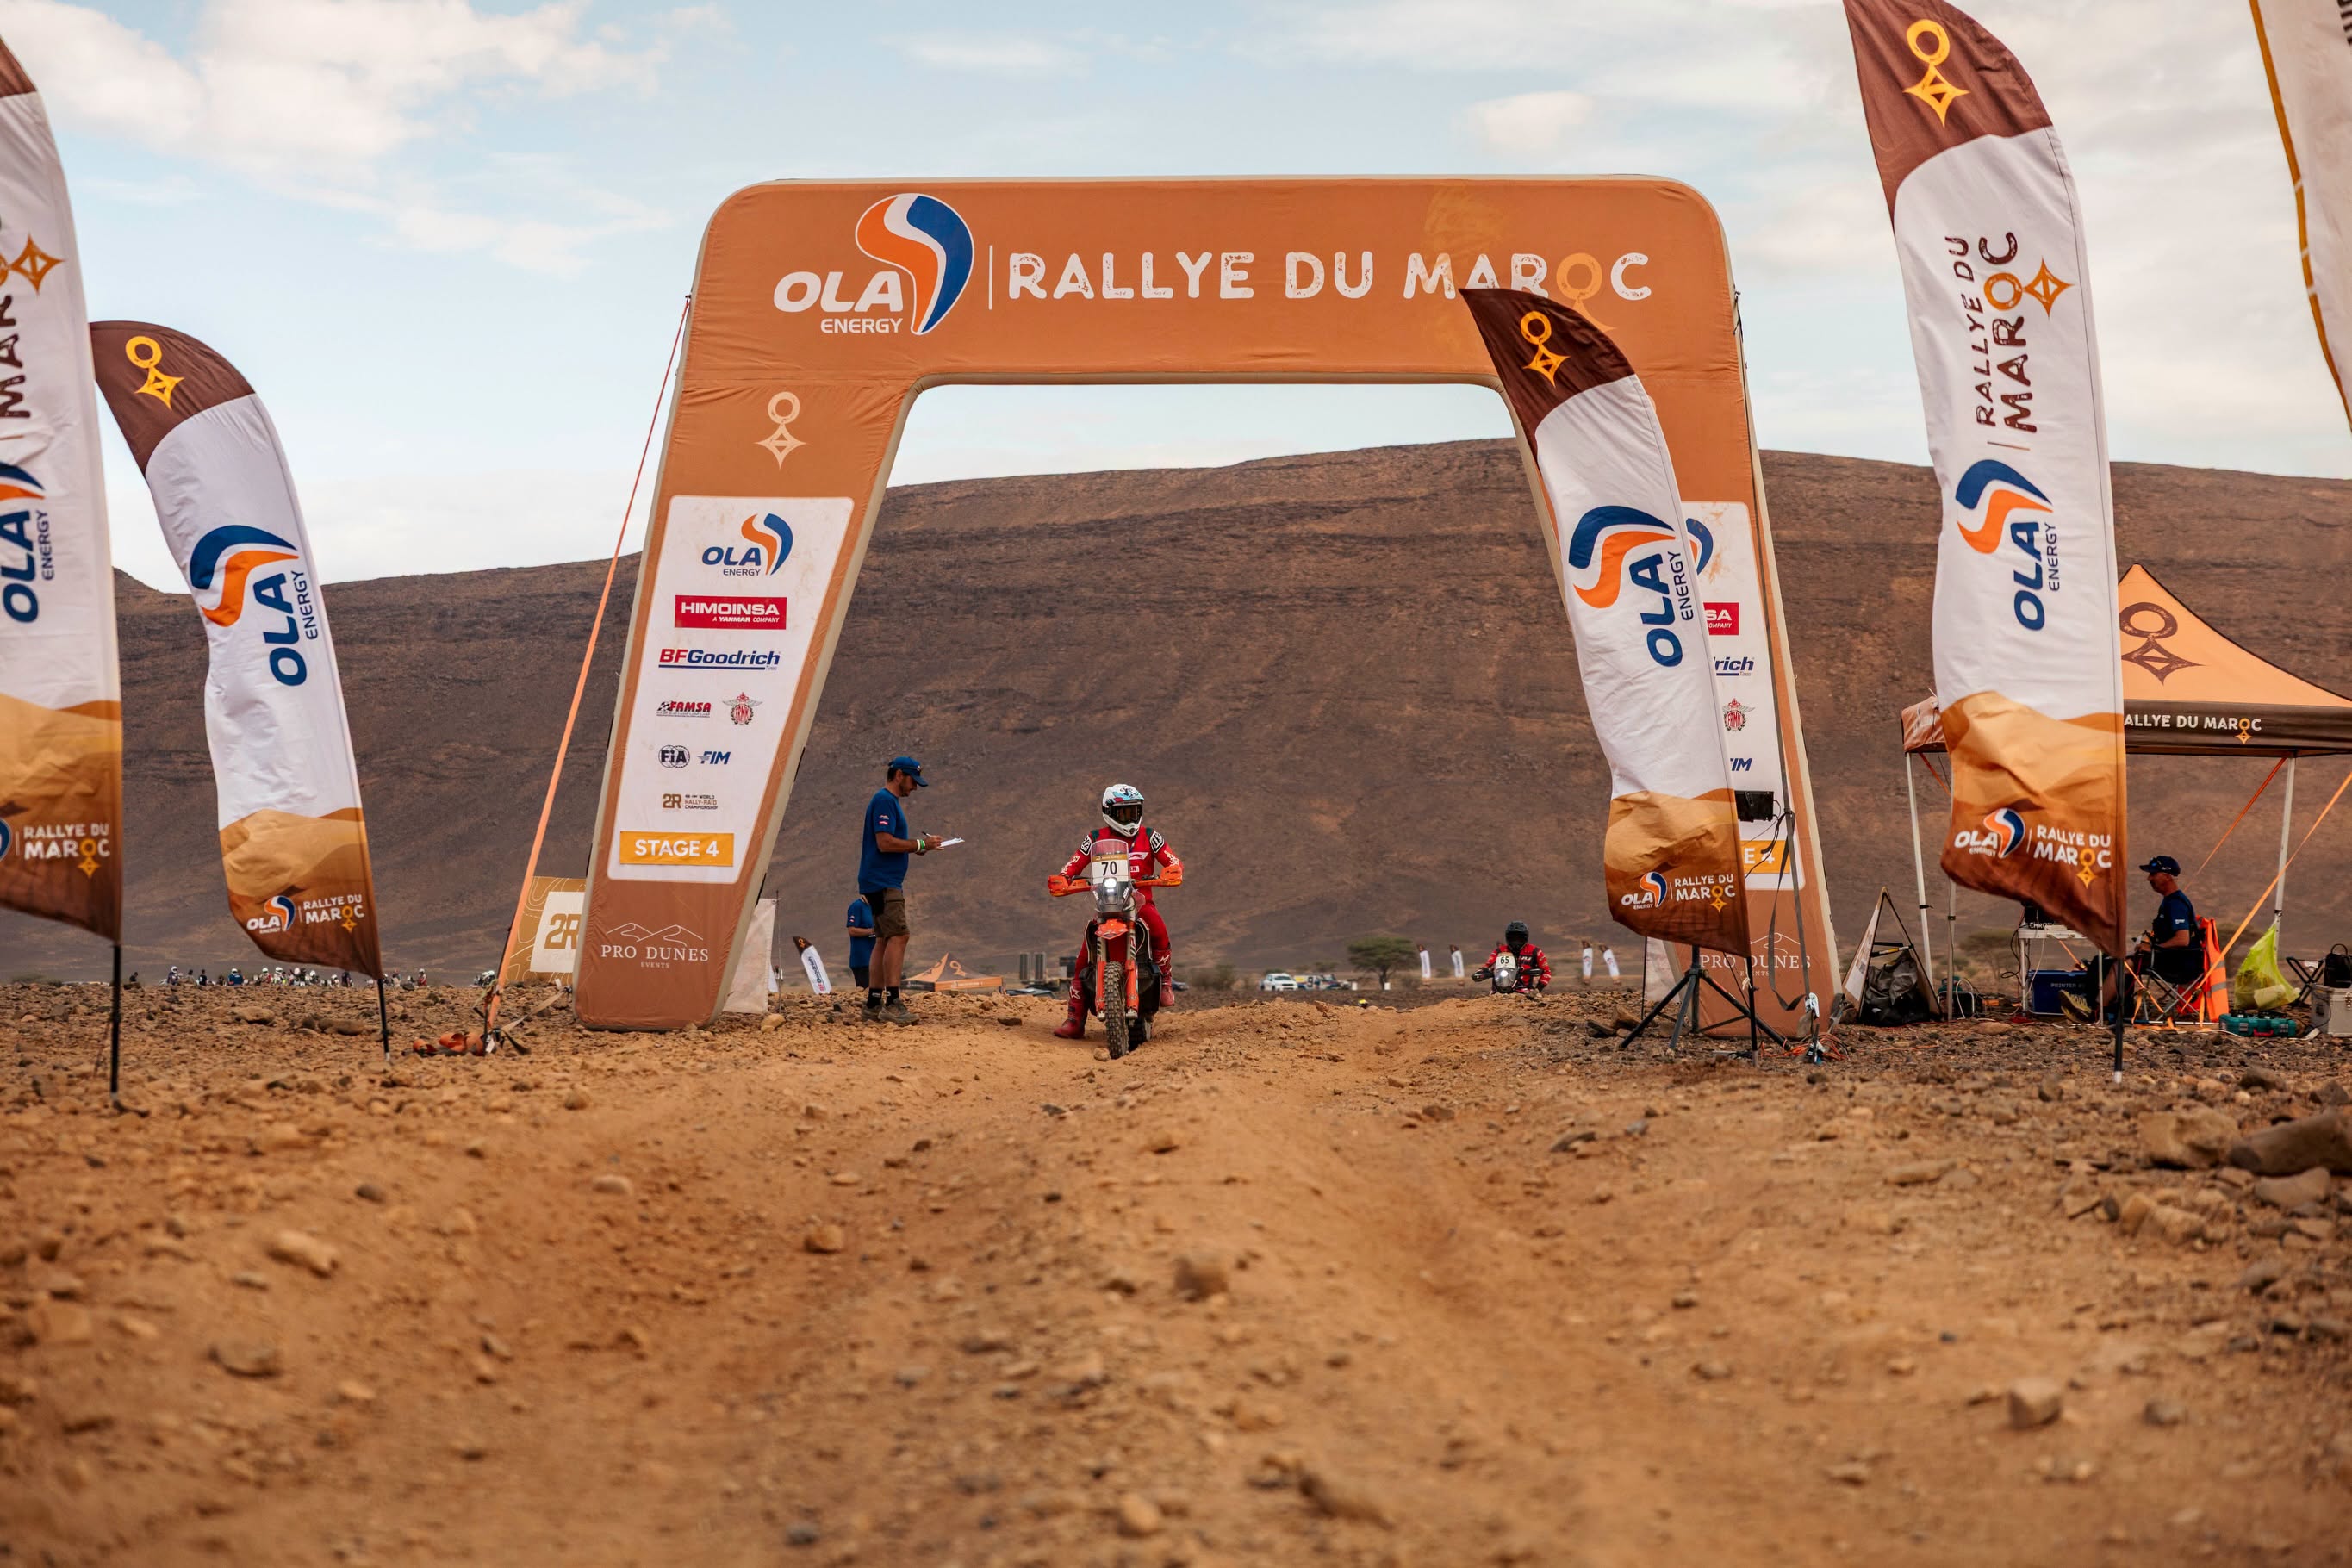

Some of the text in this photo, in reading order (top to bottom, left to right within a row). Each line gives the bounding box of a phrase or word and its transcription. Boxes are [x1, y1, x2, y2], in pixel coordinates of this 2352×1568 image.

[1009, 252, 1652, 301] RALLYE DU MAROC
[774, 271, 903, 312] OLA
[820, 318, 903, 333] ENERGY
[1945, 236, 1995, 426] RALLYE DU
[1978, 232, 2037, 433] MAROC
[36, 510, 55, 581] ENERGY
[702, 546, 761, 566] OLA
[2044, 522, 2060, 592] ENERGY
[0, 510, 39, 624] OLA
[2010, 522, 2045, 631] OLA
[1668, 551, 1694, 621] ENERGY
[291, 570, 319, 640] ENERGY
[681, 602, 780, 615] HIMOINSA
[1629, 553, 1683, 667] OLA
[253, 573, 308, 687] OLA
[659, 649, 781, 665] BFGoodrich
[669, 701, 712, 712] FAMSA
[2124, 714, 2262, 731] ALLYE DU MAROC
[700, 751, 731, 764] FIM
[1730, 757, 1752, 771] IM
[23, 823, 109, 839] RALLYE DU
[1954, 831, 1998, 849] OLA
[2037, 824, 2111, 848] RALLYE DU
[24, 838, 110, 860] MAROC
[635, 839, 719, 856] STAGE 4
[2033, 841, 2112, 868] MAROC
[1101, 861, 1117, 875] 70
[1674, 874, 1733, 887] RALLYE DU
[303, 894, 362, 910] RALLYE DU
[1621, 892, 1653, 905] OLA
[1676, 885, 1736, 901] MAROC
[246, 916, 280, 930] OLA
[305, 905, 364, 924] MAROC
[600, 944, 709, 961] PRO DUNES
[1699, 955, 1736, 968] PRO
